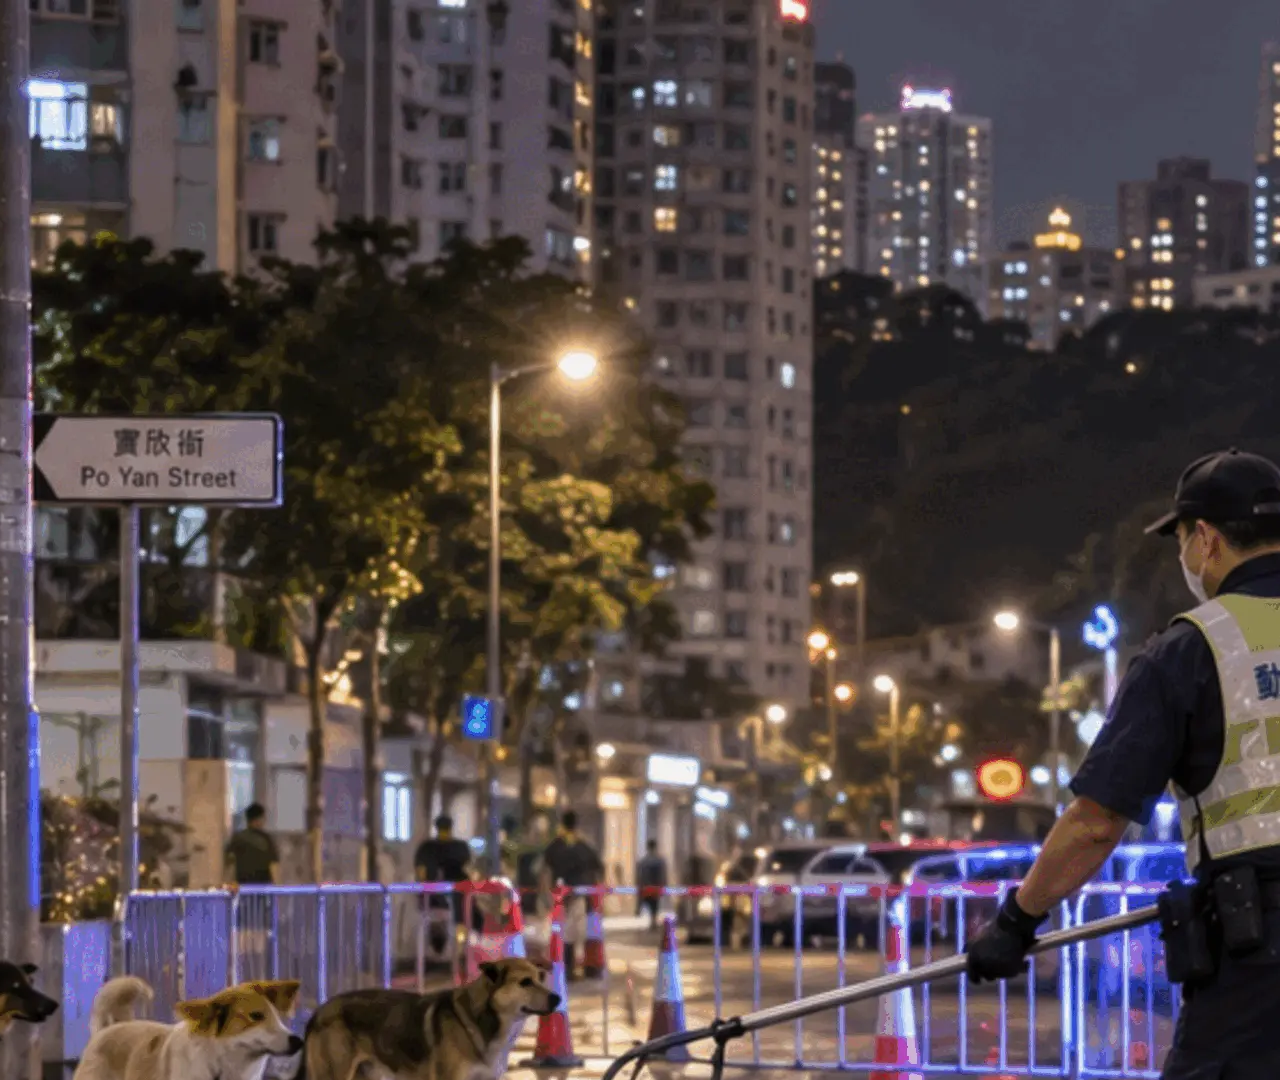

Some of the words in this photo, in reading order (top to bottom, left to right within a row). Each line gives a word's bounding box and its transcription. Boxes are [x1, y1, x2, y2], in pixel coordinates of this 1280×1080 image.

[80, 466, 110, 487] Po
[119, 466, 159, 488] Yan
[168, 466, 237, 488] Street
